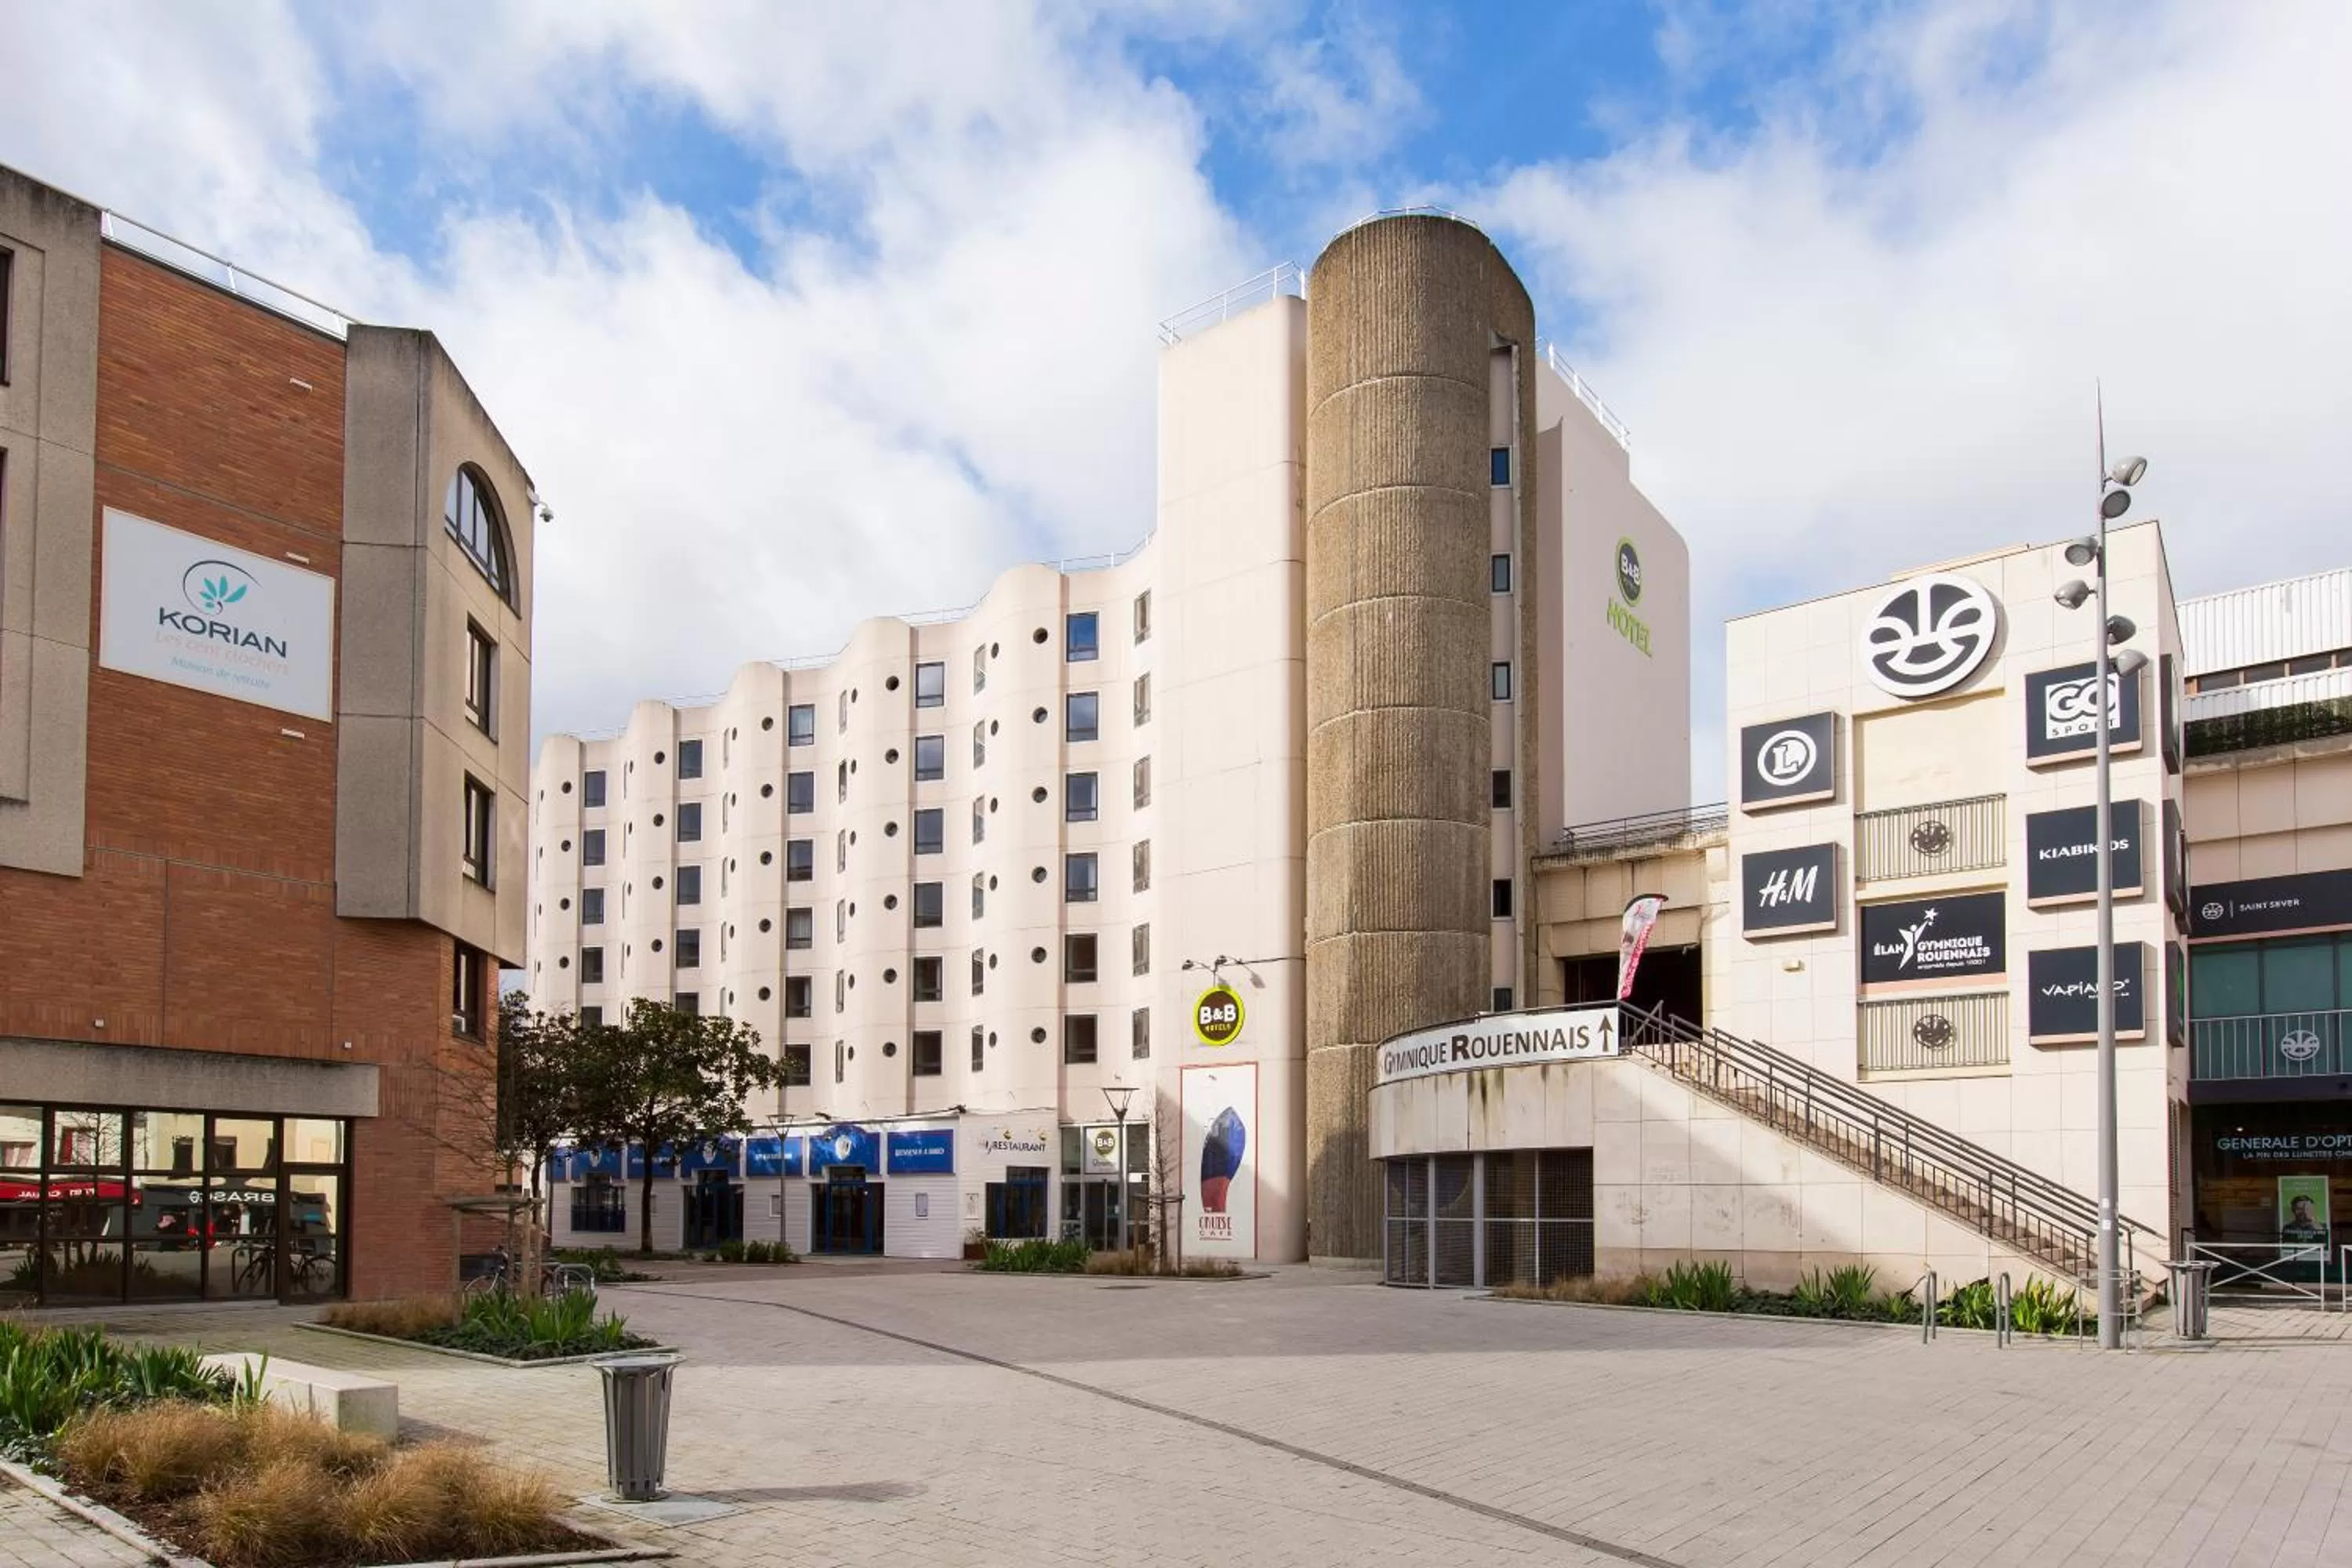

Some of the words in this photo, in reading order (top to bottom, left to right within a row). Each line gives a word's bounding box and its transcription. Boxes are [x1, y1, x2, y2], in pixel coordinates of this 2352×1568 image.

[1621, 552, 1640, 586] B&B
[159, 607, 287, 659] KORIAN
[2049, 679, 2116, 722] GO
[1759, 865, 1818, 907] H&M
[2239, 902, 2267, 912] SAINT
[2270, 898, 2300, 909] SEVER
[1874, 941, 1904, 956] ÉLAN
[1917, 935, 1983, 952] GYMNIQUE
[1917, 946, 1991, 963] ROUENNAIS
[2042, 981, 2125, 996] VAPIAO
[1200, 1004, 1236, 1025] B&B
[1451, 1025, 1591, 1062] ROUENNAIS
[1097, 1138, 1114, 1147] B&B
[2217, 1137, 2299, 1150] GENERALE
